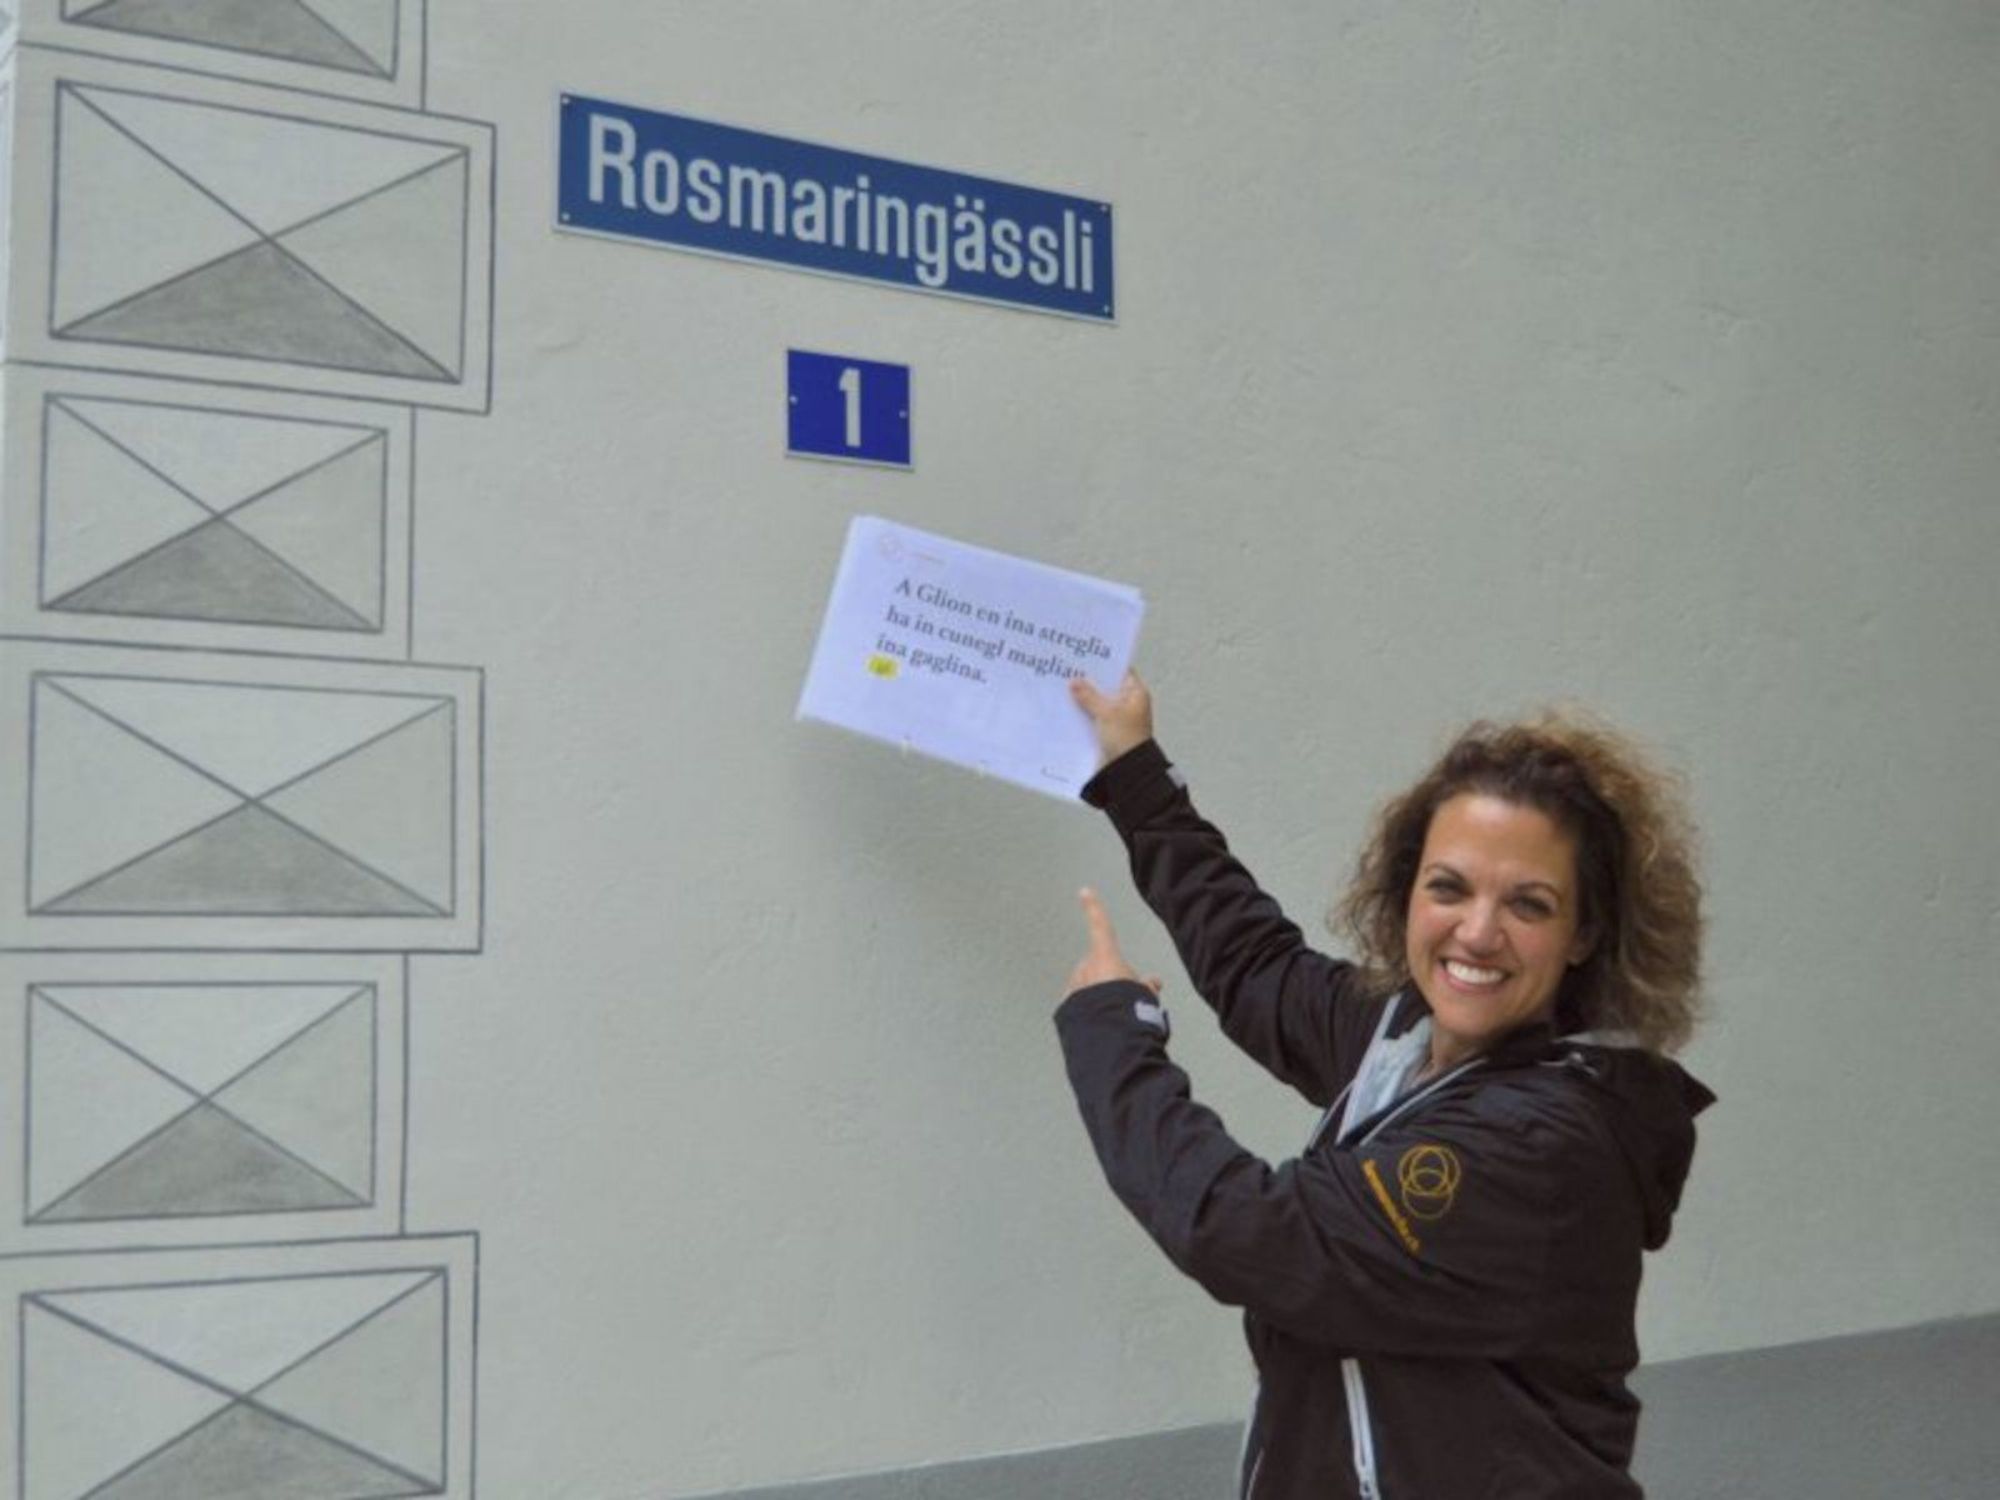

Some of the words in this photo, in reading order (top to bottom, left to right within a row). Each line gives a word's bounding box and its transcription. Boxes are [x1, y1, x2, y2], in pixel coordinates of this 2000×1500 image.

[588, 112, 1094, 294] Rosmaringässli
[838, 367, 862, 448] 1
[876, 633, 907, 658] ina
[909, 648, 987, 685] gaglina.
[886, 603, 911, 628] ha
[914, 613, 935, 636] in
[938, 625, 1005, 660] cunegl
[894, 578, 911, 597] A
[917, 583, 973, 616] Glion
[976, 607, 1000, 625] en
[1004, 609, 1035, 636] ina
[1038, 627, 1111, 659] streglia
